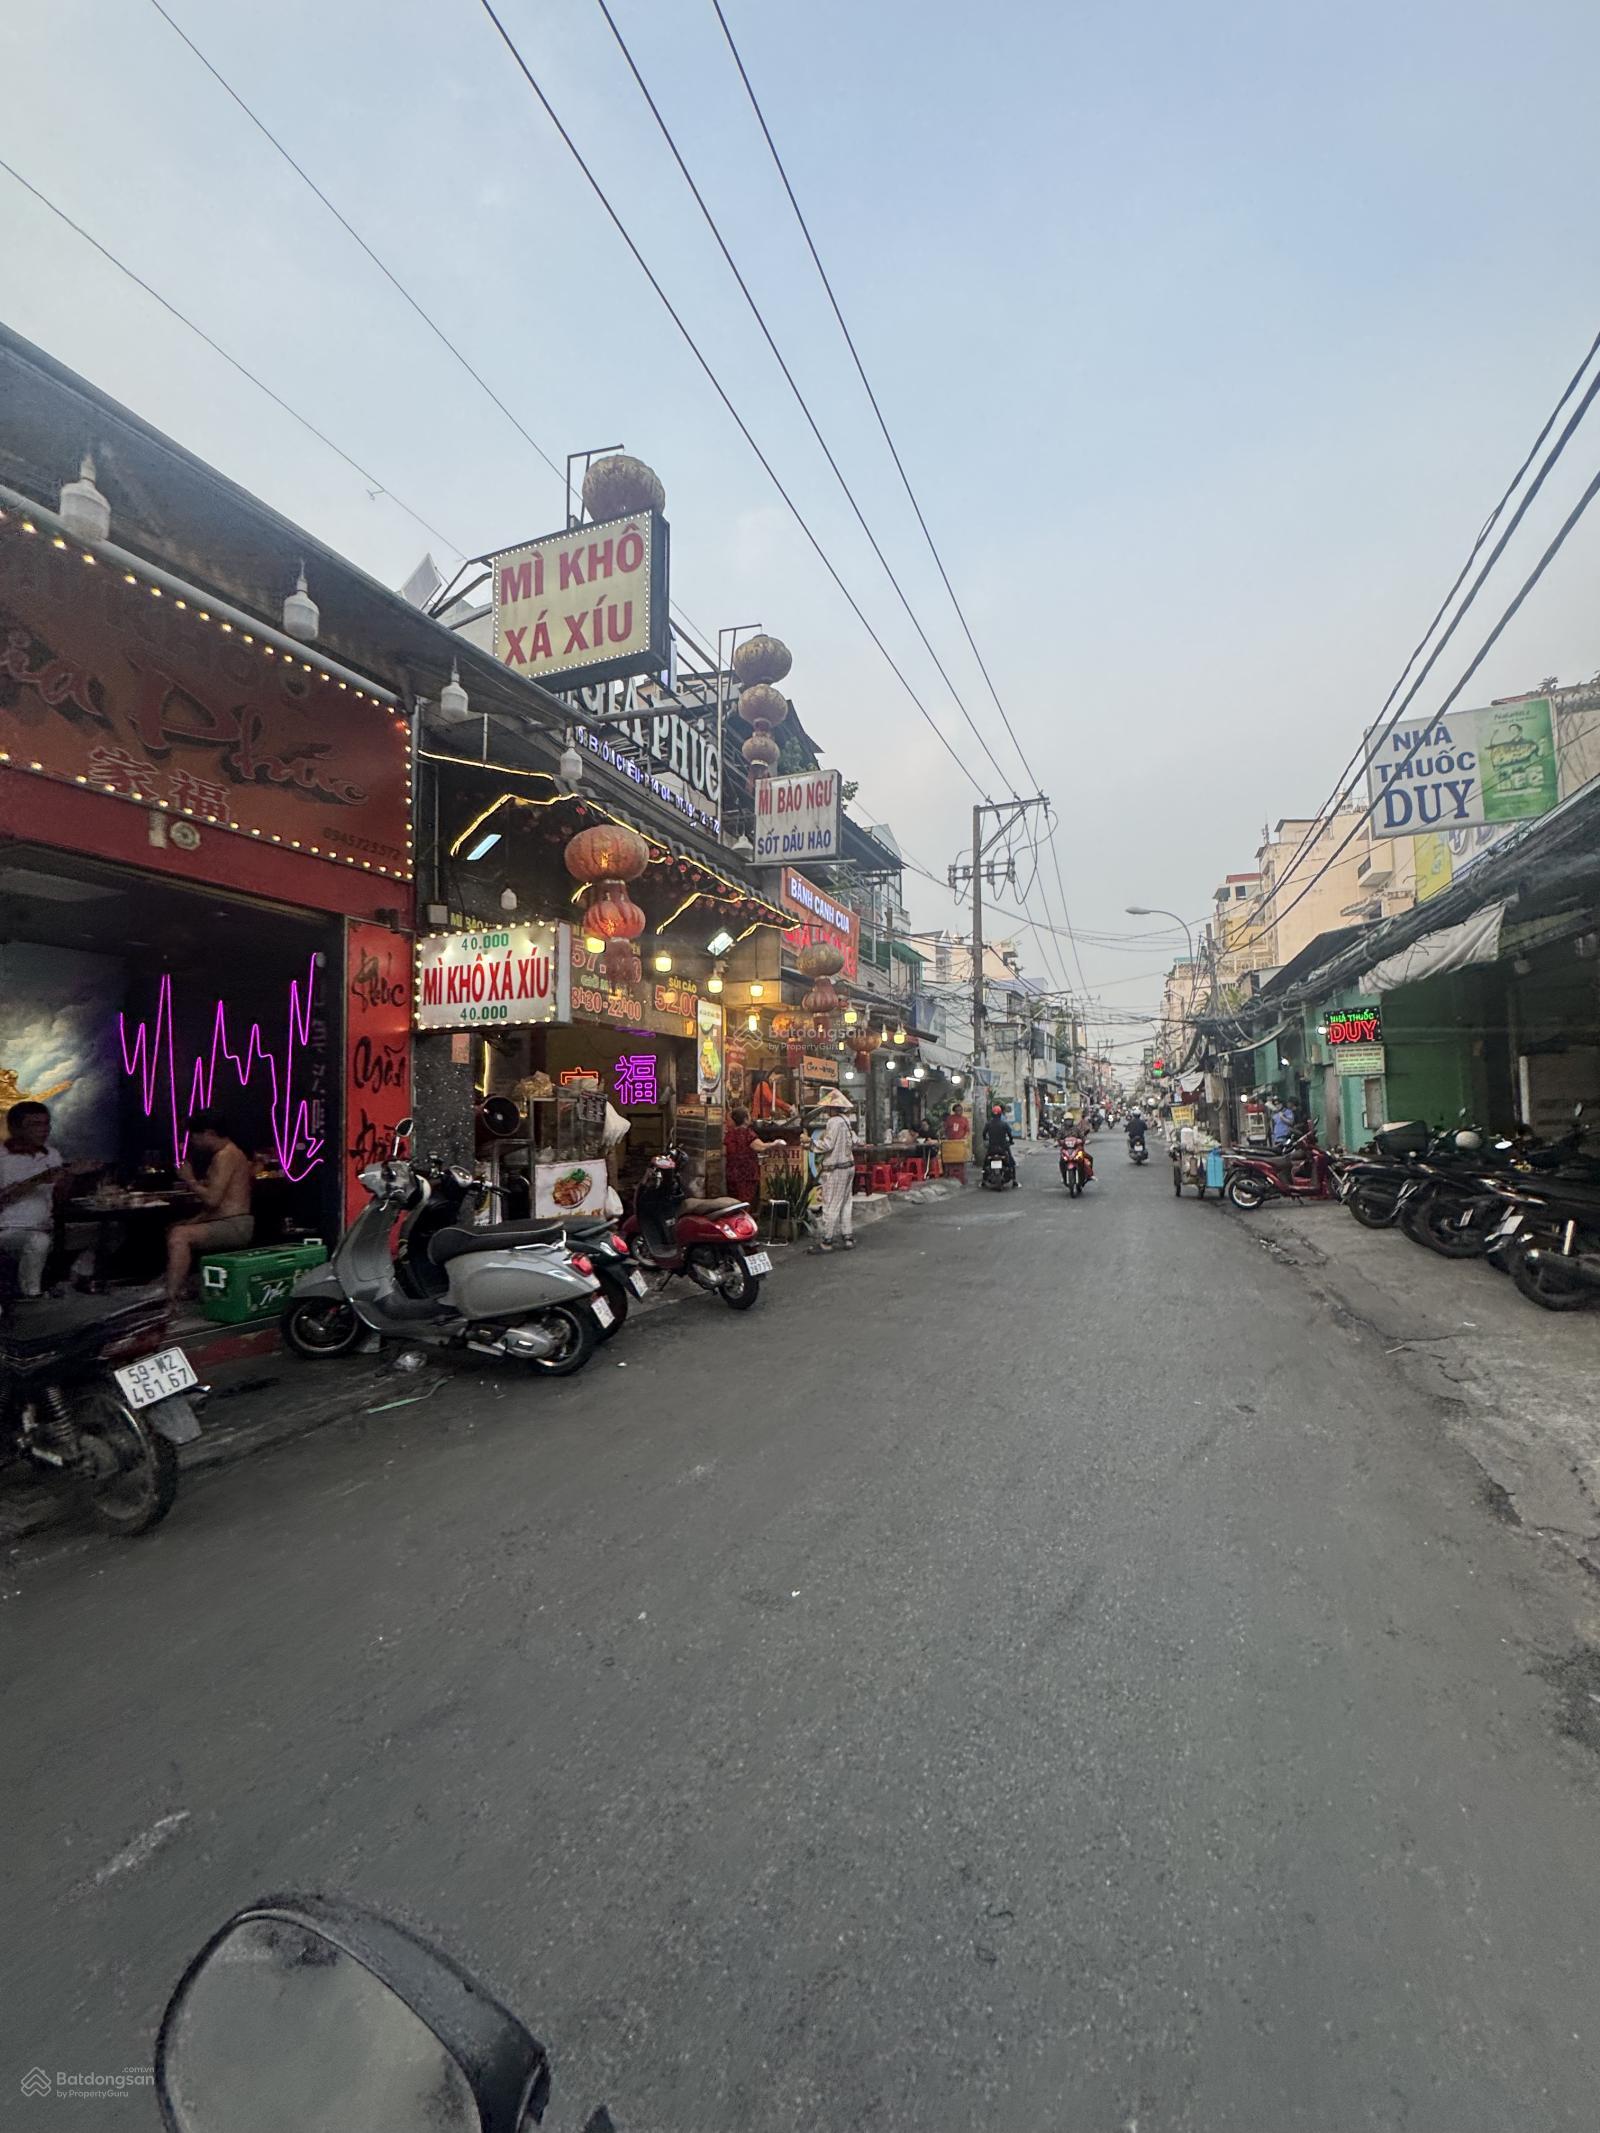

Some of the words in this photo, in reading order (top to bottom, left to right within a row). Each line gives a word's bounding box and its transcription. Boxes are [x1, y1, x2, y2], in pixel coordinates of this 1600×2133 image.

[501, 550, 544, 606] MÌ
[559, 523, 645, 591] KHÔ
[504, 609, 553, 667] XÁ
[563, 594, 633, 655] XÍU
[1392, 721, 1453, 752] NHÀ
[1375, 745, 1476, 783] THUỐC
[758, 782, 773, 816] MÌ
[806, 774, 834, 810] NGƯ
[1384, 778, 1475, 829] DUY
[757, 828, 780, 855] SỐT
[782, 825, 805, 853] DẦU
[807, 825, 832, 850] HÀO
[790, 878, 813, 910] BÁNH
[814, 895, 835, 924] CANH
[835, 910, 850, 935] CUA
[461, 933, 509, 951] 40.000
[423, 957, 443, 1006] MÌ
[447, 953, 485, 1004] KHÔ
[488, 949, 514, 1001] XÁ
[517, 947, 549, 999] XÍU
[460, 1005, 508, 1021] 40.000
[1330, 1012, 1347, 1023] NHÀ
[1347, 1009, 1375, 1022] THUỐC
[1330, 1019, 1377, 1043] DUY
[614, 1054, 657, 1105] 福
